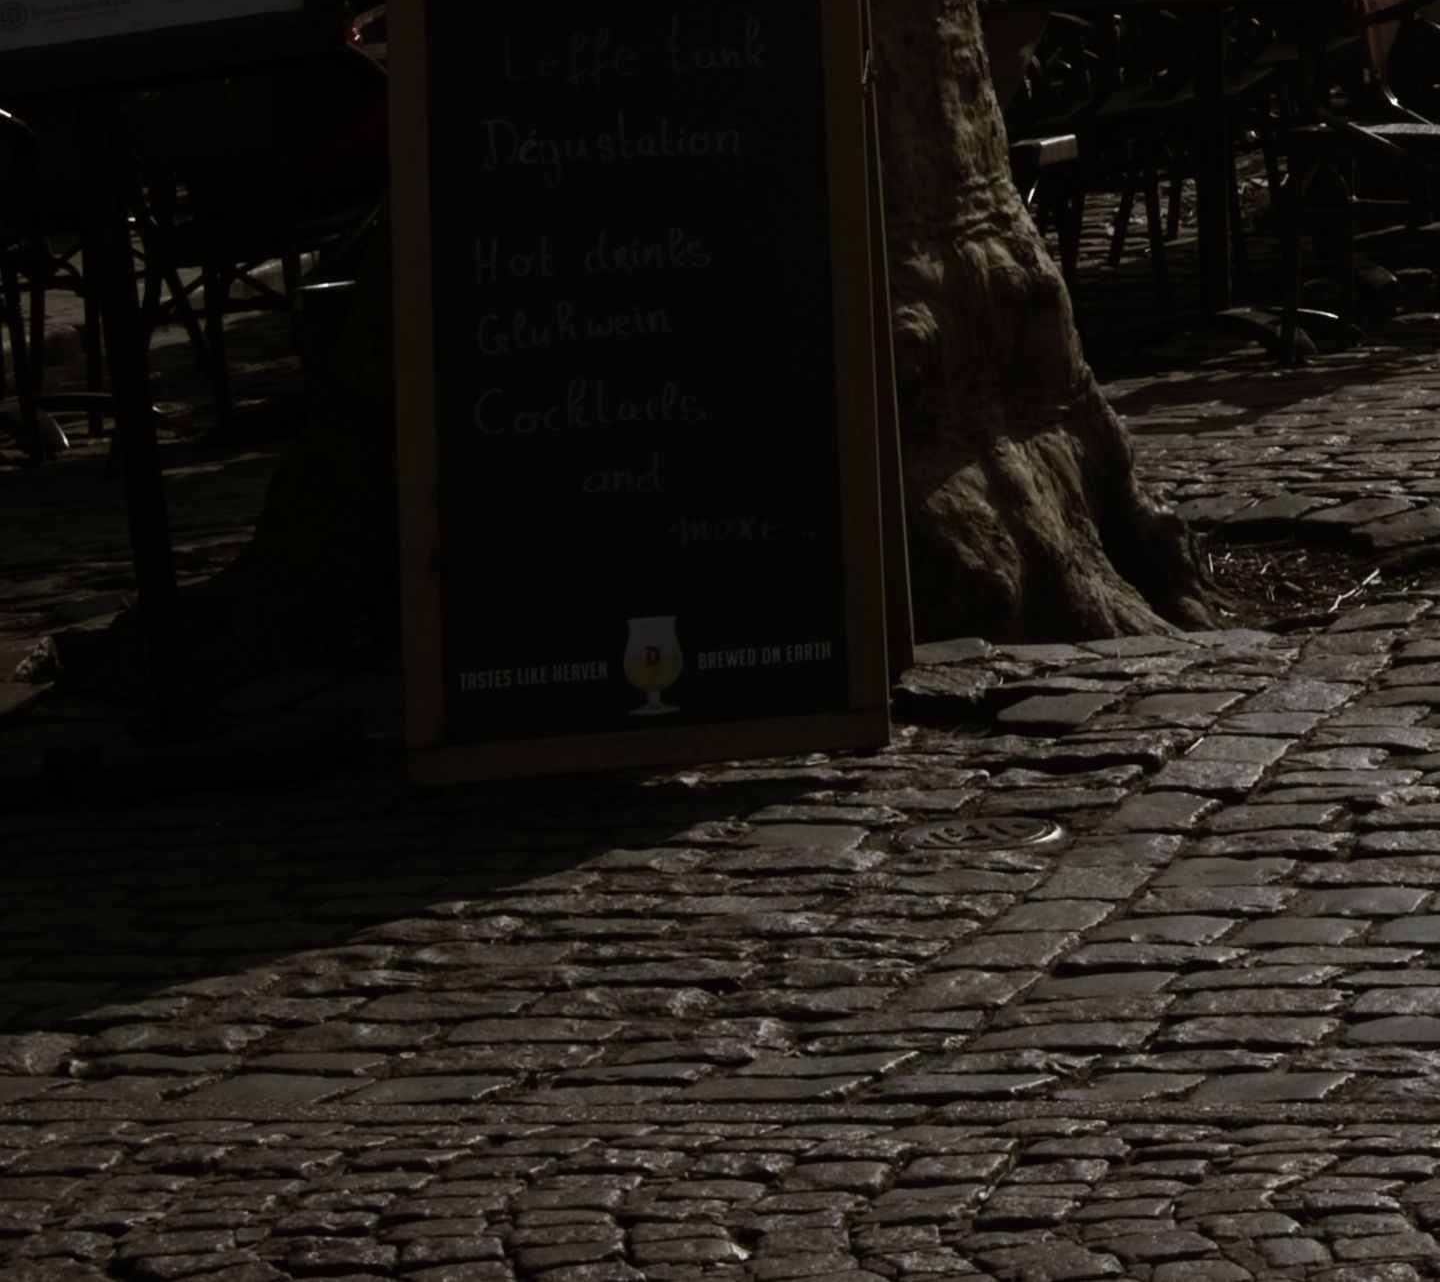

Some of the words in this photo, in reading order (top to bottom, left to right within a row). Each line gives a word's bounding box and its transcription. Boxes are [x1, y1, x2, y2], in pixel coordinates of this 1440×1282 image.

[503, 28, 641, 88] Leffe
[670, 13, 767, 72] tank
[479, 111, 744, 188] Dégustation
[474, 235, 557, 284] Hot
[583, 226, 713, 273] drinks
[476, 299, 674, 357] Glühwein
[473, 376, 708, 436] Cocktails
[581, 451, 668, 494] and
[458, 667, 513, 692] TASTES
[517, 665, 548, 687] LIKE
[552, 660, 609, 685] HEAVEN
[698, 646, 757, 671] BREWED
[761, 645, 781, 665] ON
[785, 640, 833, 663] EARTH
